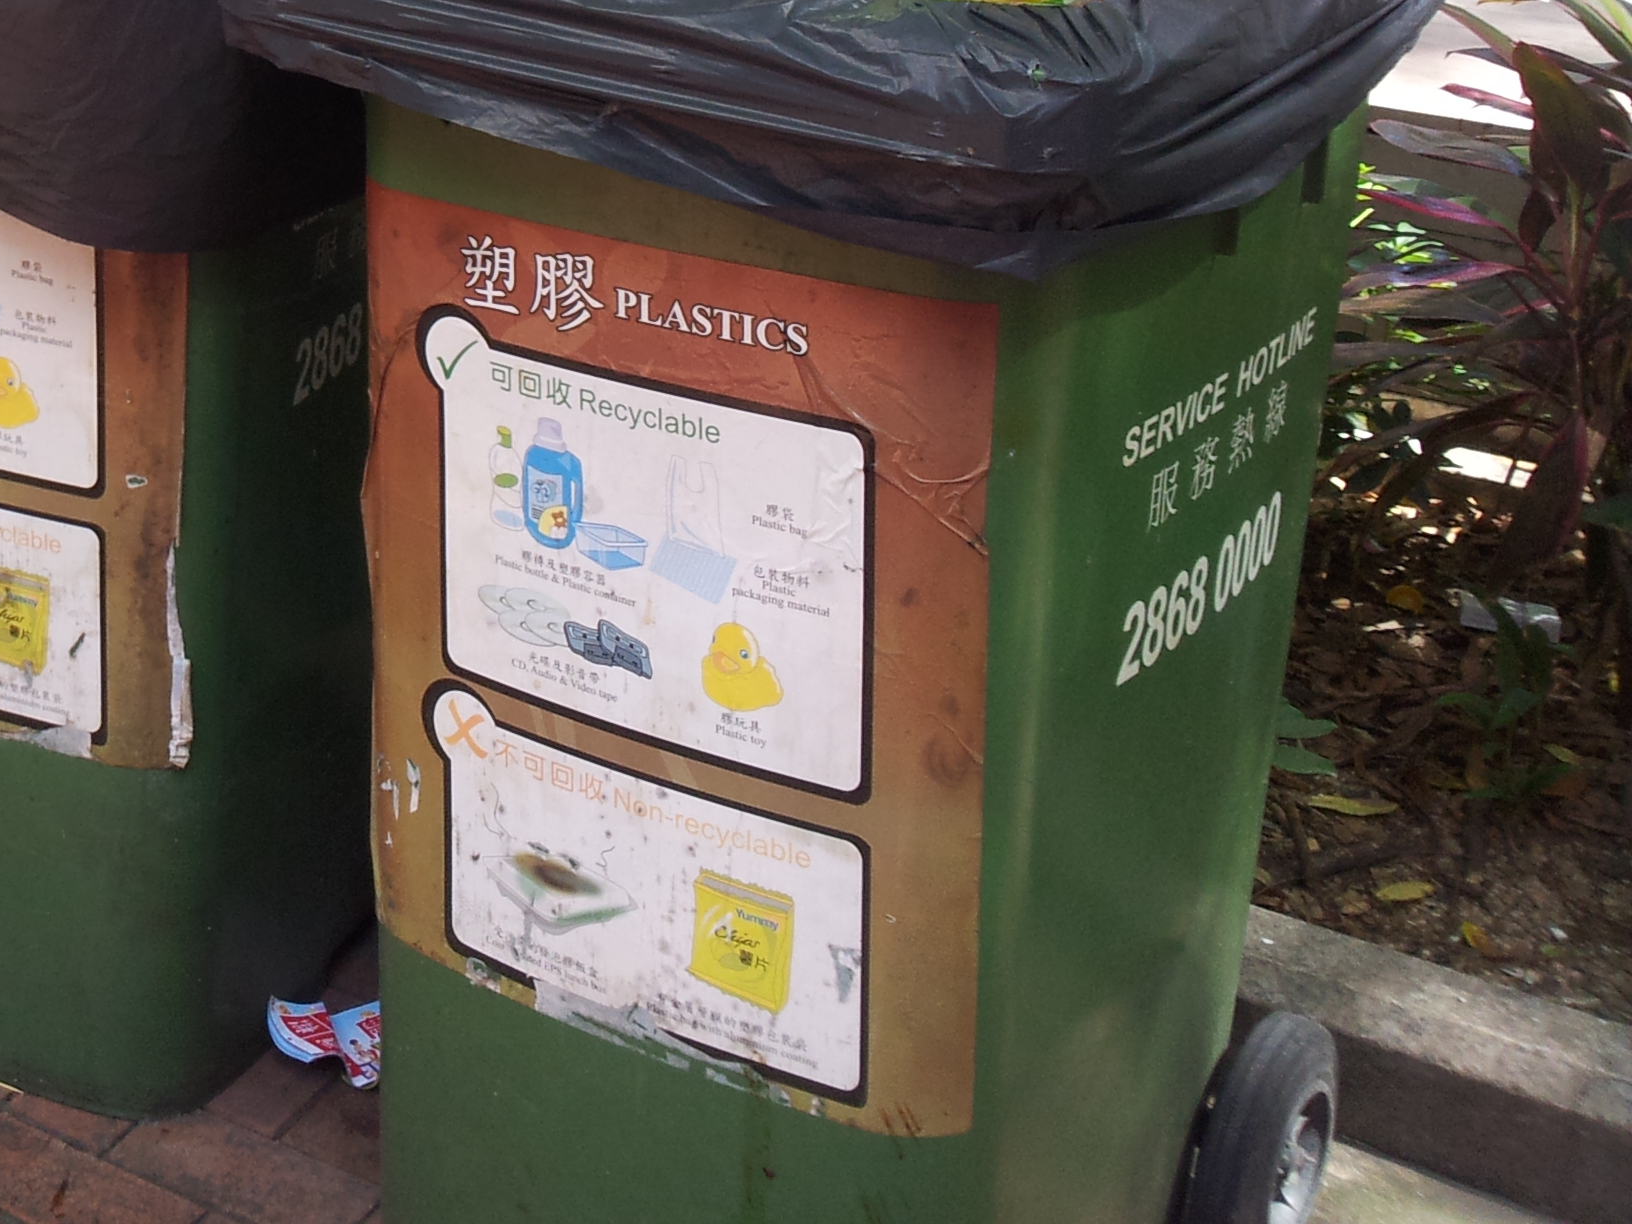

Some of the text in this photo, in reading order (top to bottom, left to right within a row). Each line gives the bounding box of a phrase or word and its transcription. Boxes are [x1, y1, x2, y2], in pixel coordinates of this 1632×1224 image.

[460, 235, 812, 358] 塑膠 PLASTICS
[41, 334, 73, 349] material
[489, 360, 722, 445] 可回收 Recyclable
[1122, 306, 1318, 468] SERVICE HOTLINE
[1147, 378, 1289, 534] 服務熱線
[752, 514, 808, 540] Plastic bag
[766, 504, 795, 521] 膠袋
[495, 554, 637, 607] Plastic bottle & Plastic container
[753, 564, 810, 589] 包裝物料
[762, 580, 796, 597] Plastic
[1116, 489, 1282, 687] 2868 0000
[731, 586, 831, 618] packaging material
[531, 665, 557, 682] Audio
[559, 676, 568, 686] &
[570, 678, 597, 695] Video
[598, 688, 618, 703] tape
[715, 724, 767, 749] Plastic toy
[720, 712, 762, 734] 膠玩具
[495, 738, 813, 869] 不可回收 Non-recyclable
